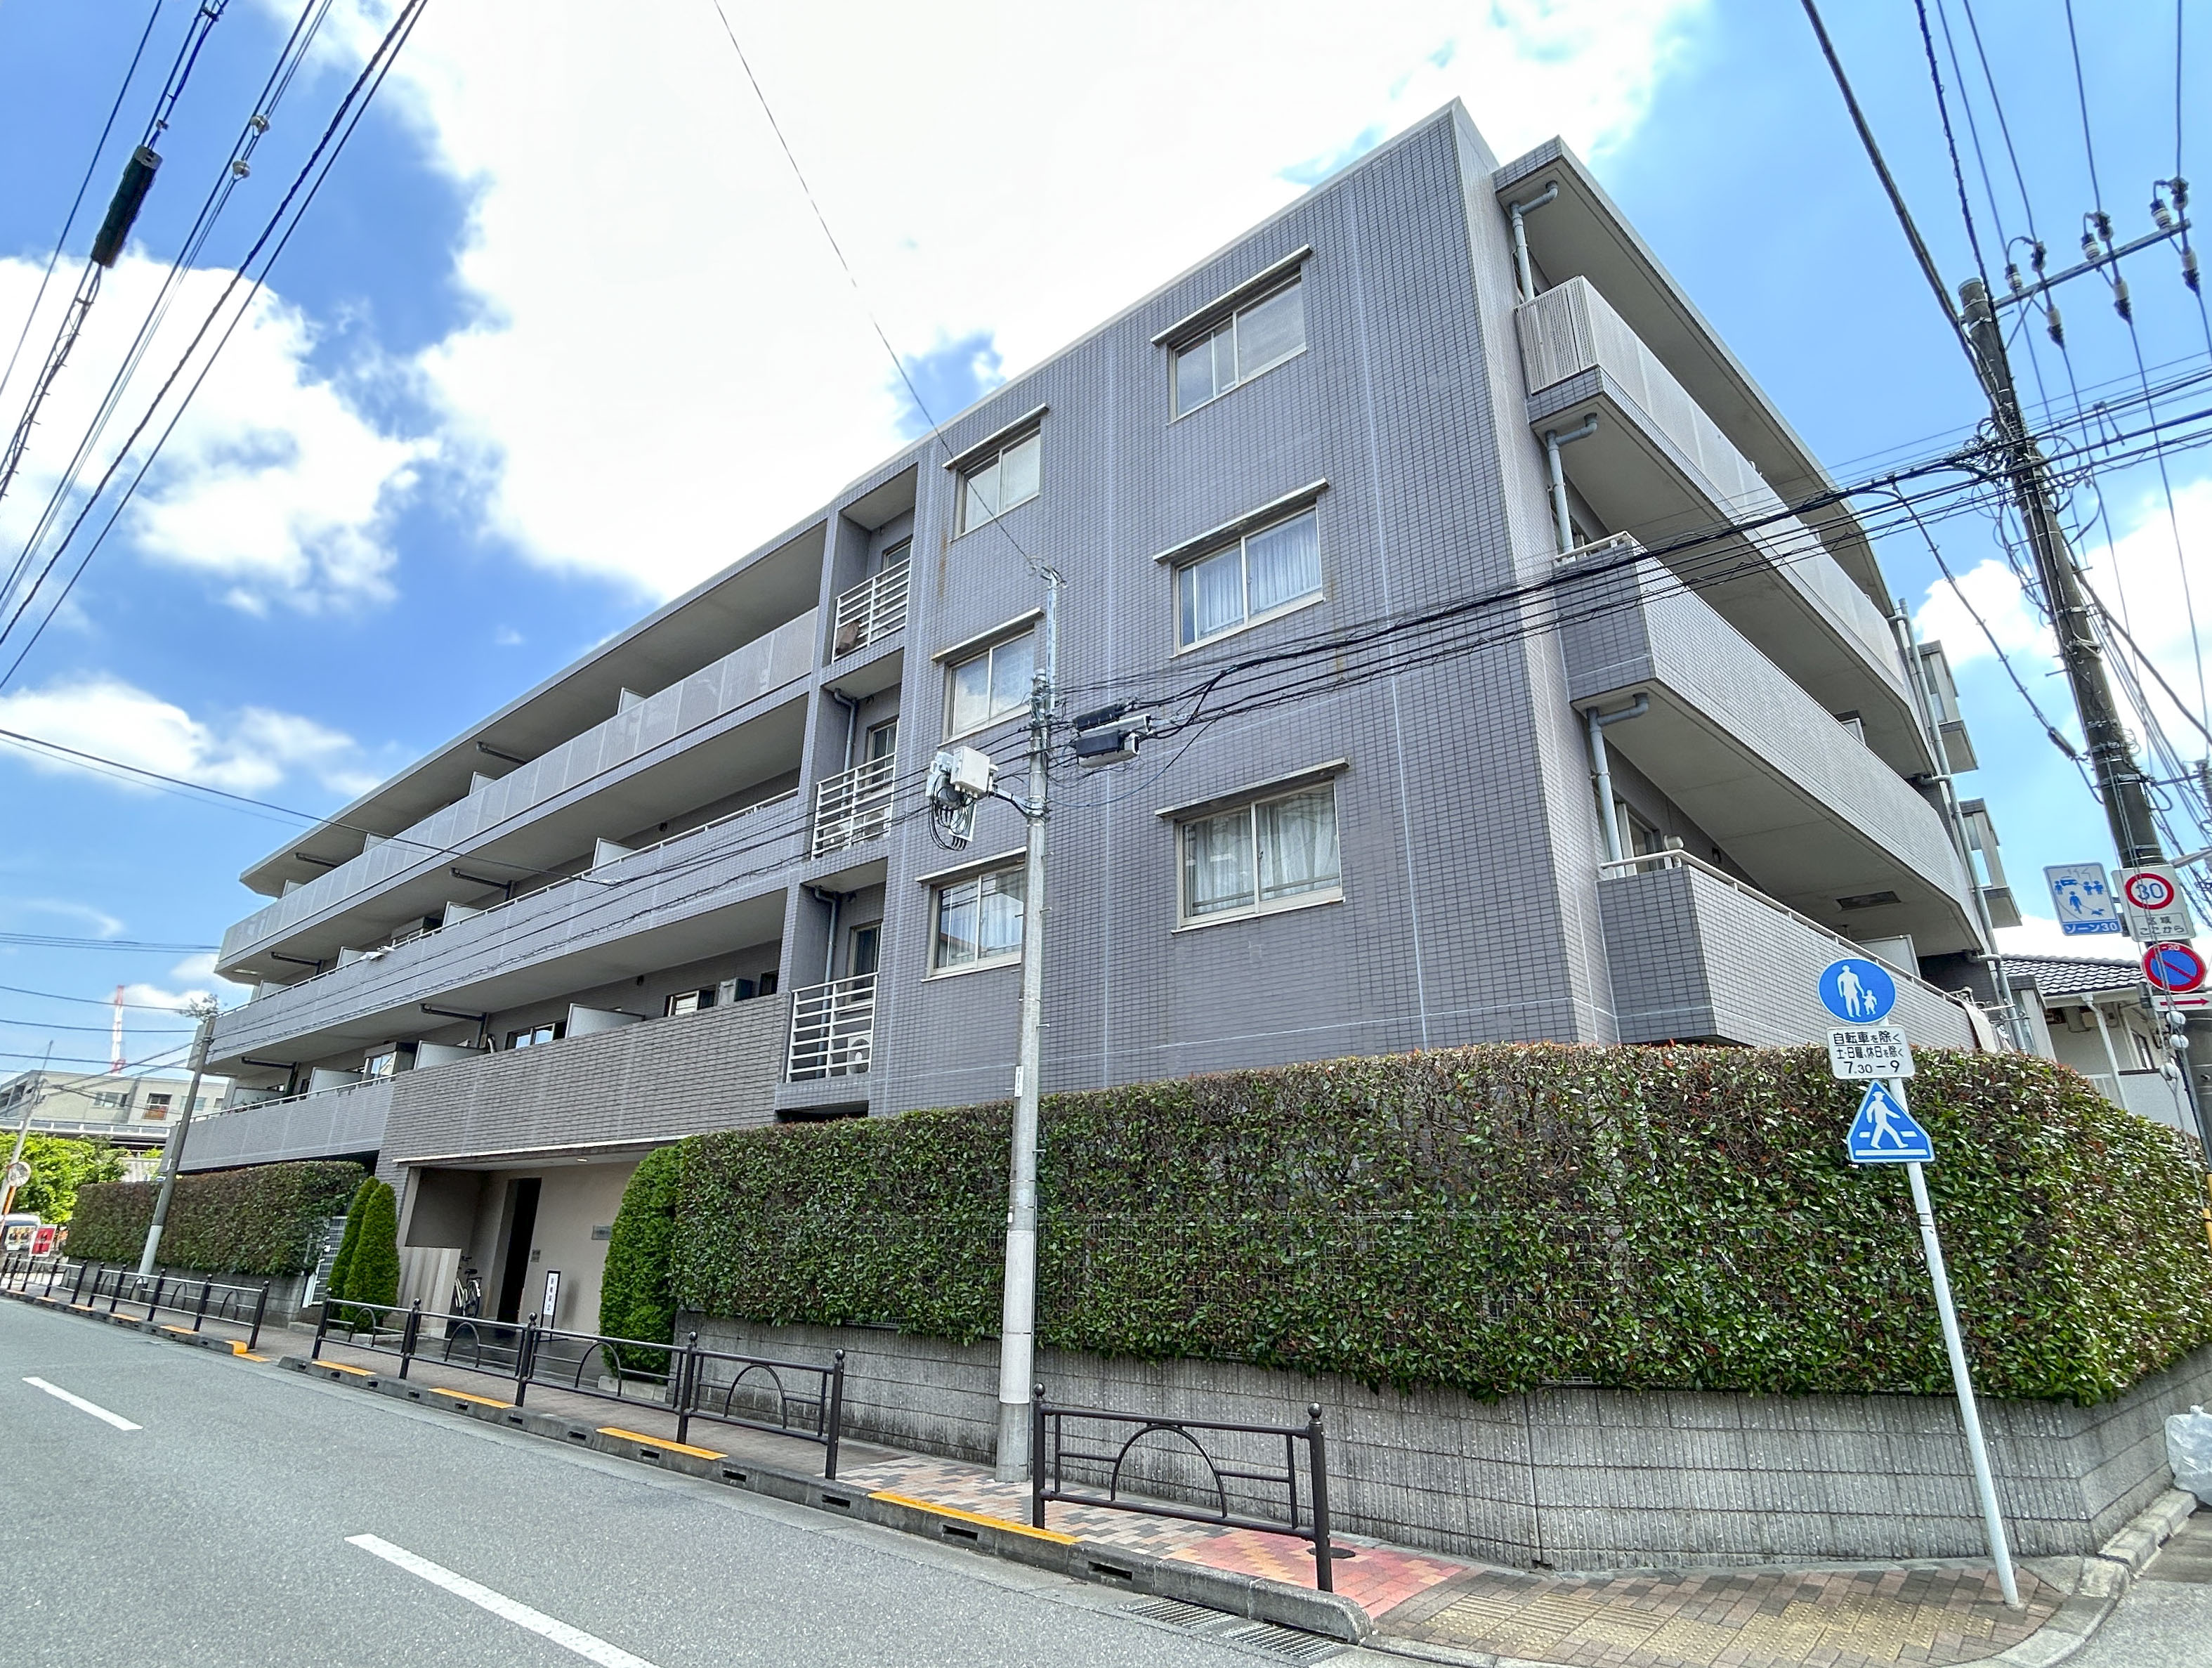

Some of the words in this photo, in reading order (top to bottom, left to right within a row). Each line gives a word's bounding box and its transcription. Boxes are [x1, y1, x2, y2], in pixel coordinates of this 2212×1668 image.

[2135, 883, 2164, 899] 30
[2139, 925, 2185, 935] ここから
[1833, 1030, 1901, 1044] 自転車を除く
